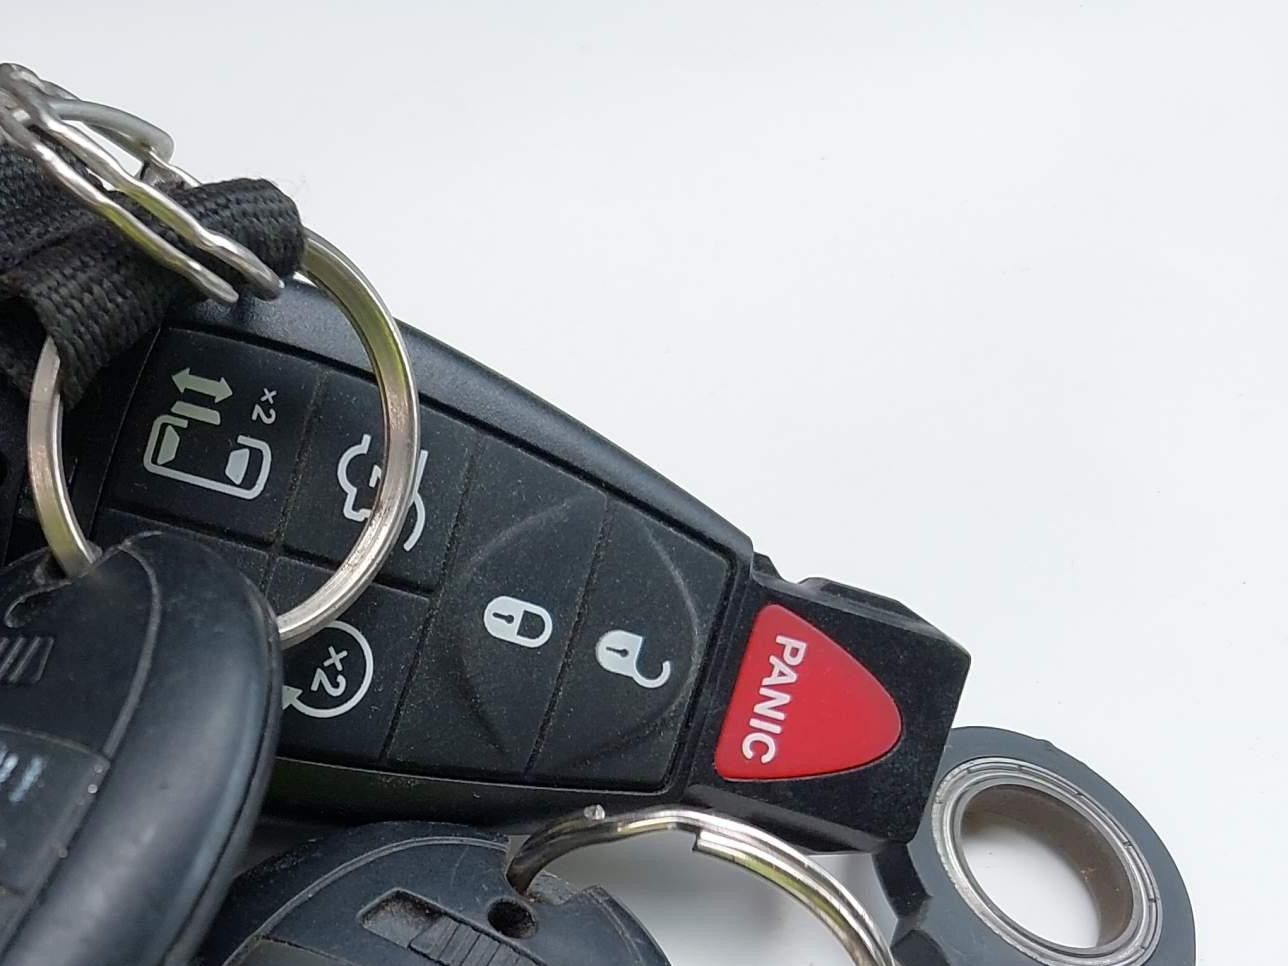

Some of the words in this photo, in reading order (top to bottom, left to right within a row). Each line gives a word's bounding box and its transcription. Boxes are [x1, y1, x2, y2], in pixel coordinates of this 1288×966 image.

[250, 388, 278, 425] x2
[309, 645, 349, 698] x2
[741, 634, 807, 765] PANIC
